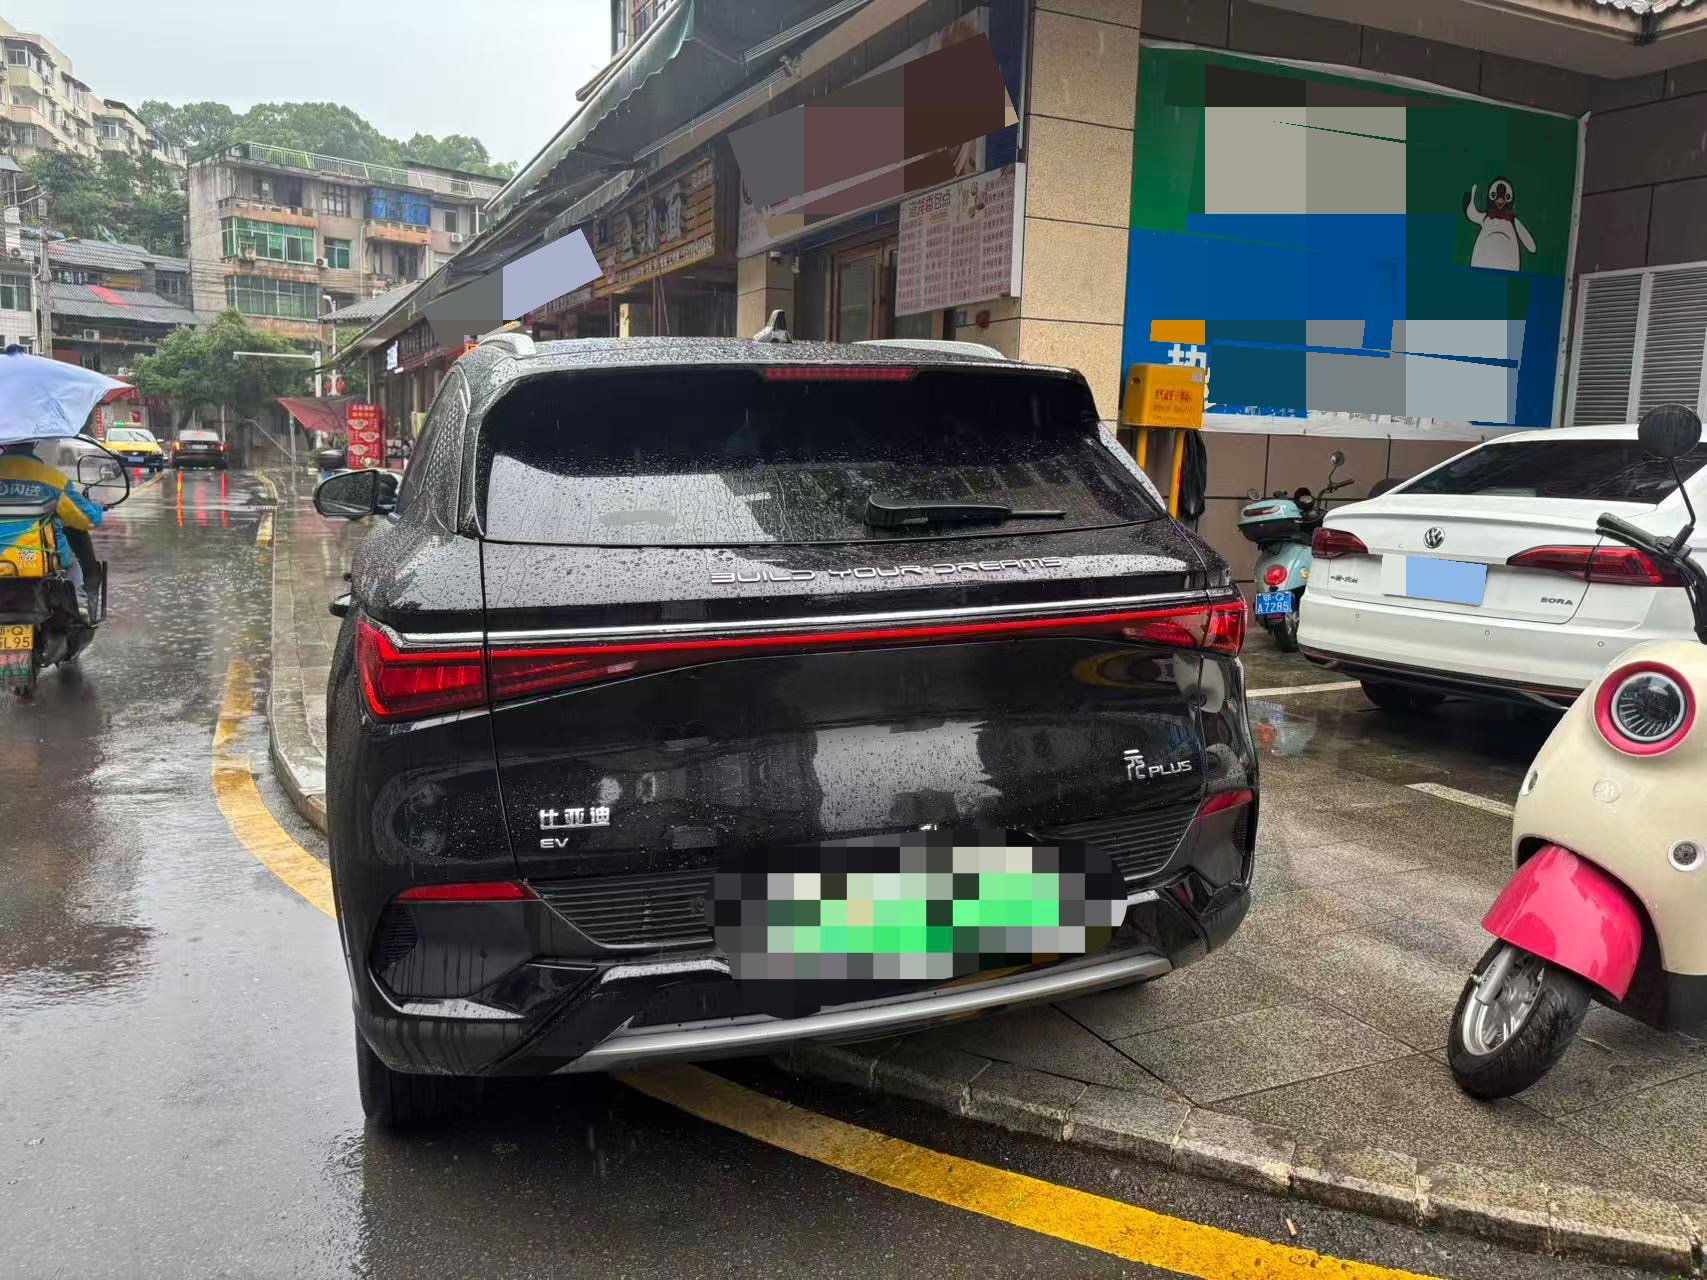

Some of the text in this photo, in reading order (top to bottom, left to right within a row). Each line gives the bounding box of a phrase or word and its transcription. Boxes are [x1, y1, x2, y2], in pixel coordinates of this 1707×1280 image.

[711, 557, 1063, 584] BUILD YOUR DREAMS
[1257, 602, 1289, 614] A7285
[1540, 597, 1573, 606] BORA
[1123, 749, 1192, 780] 元 PLUS
[540, 806, 610, 830] 比亚迪
[540, 837, 569, 849] EV
